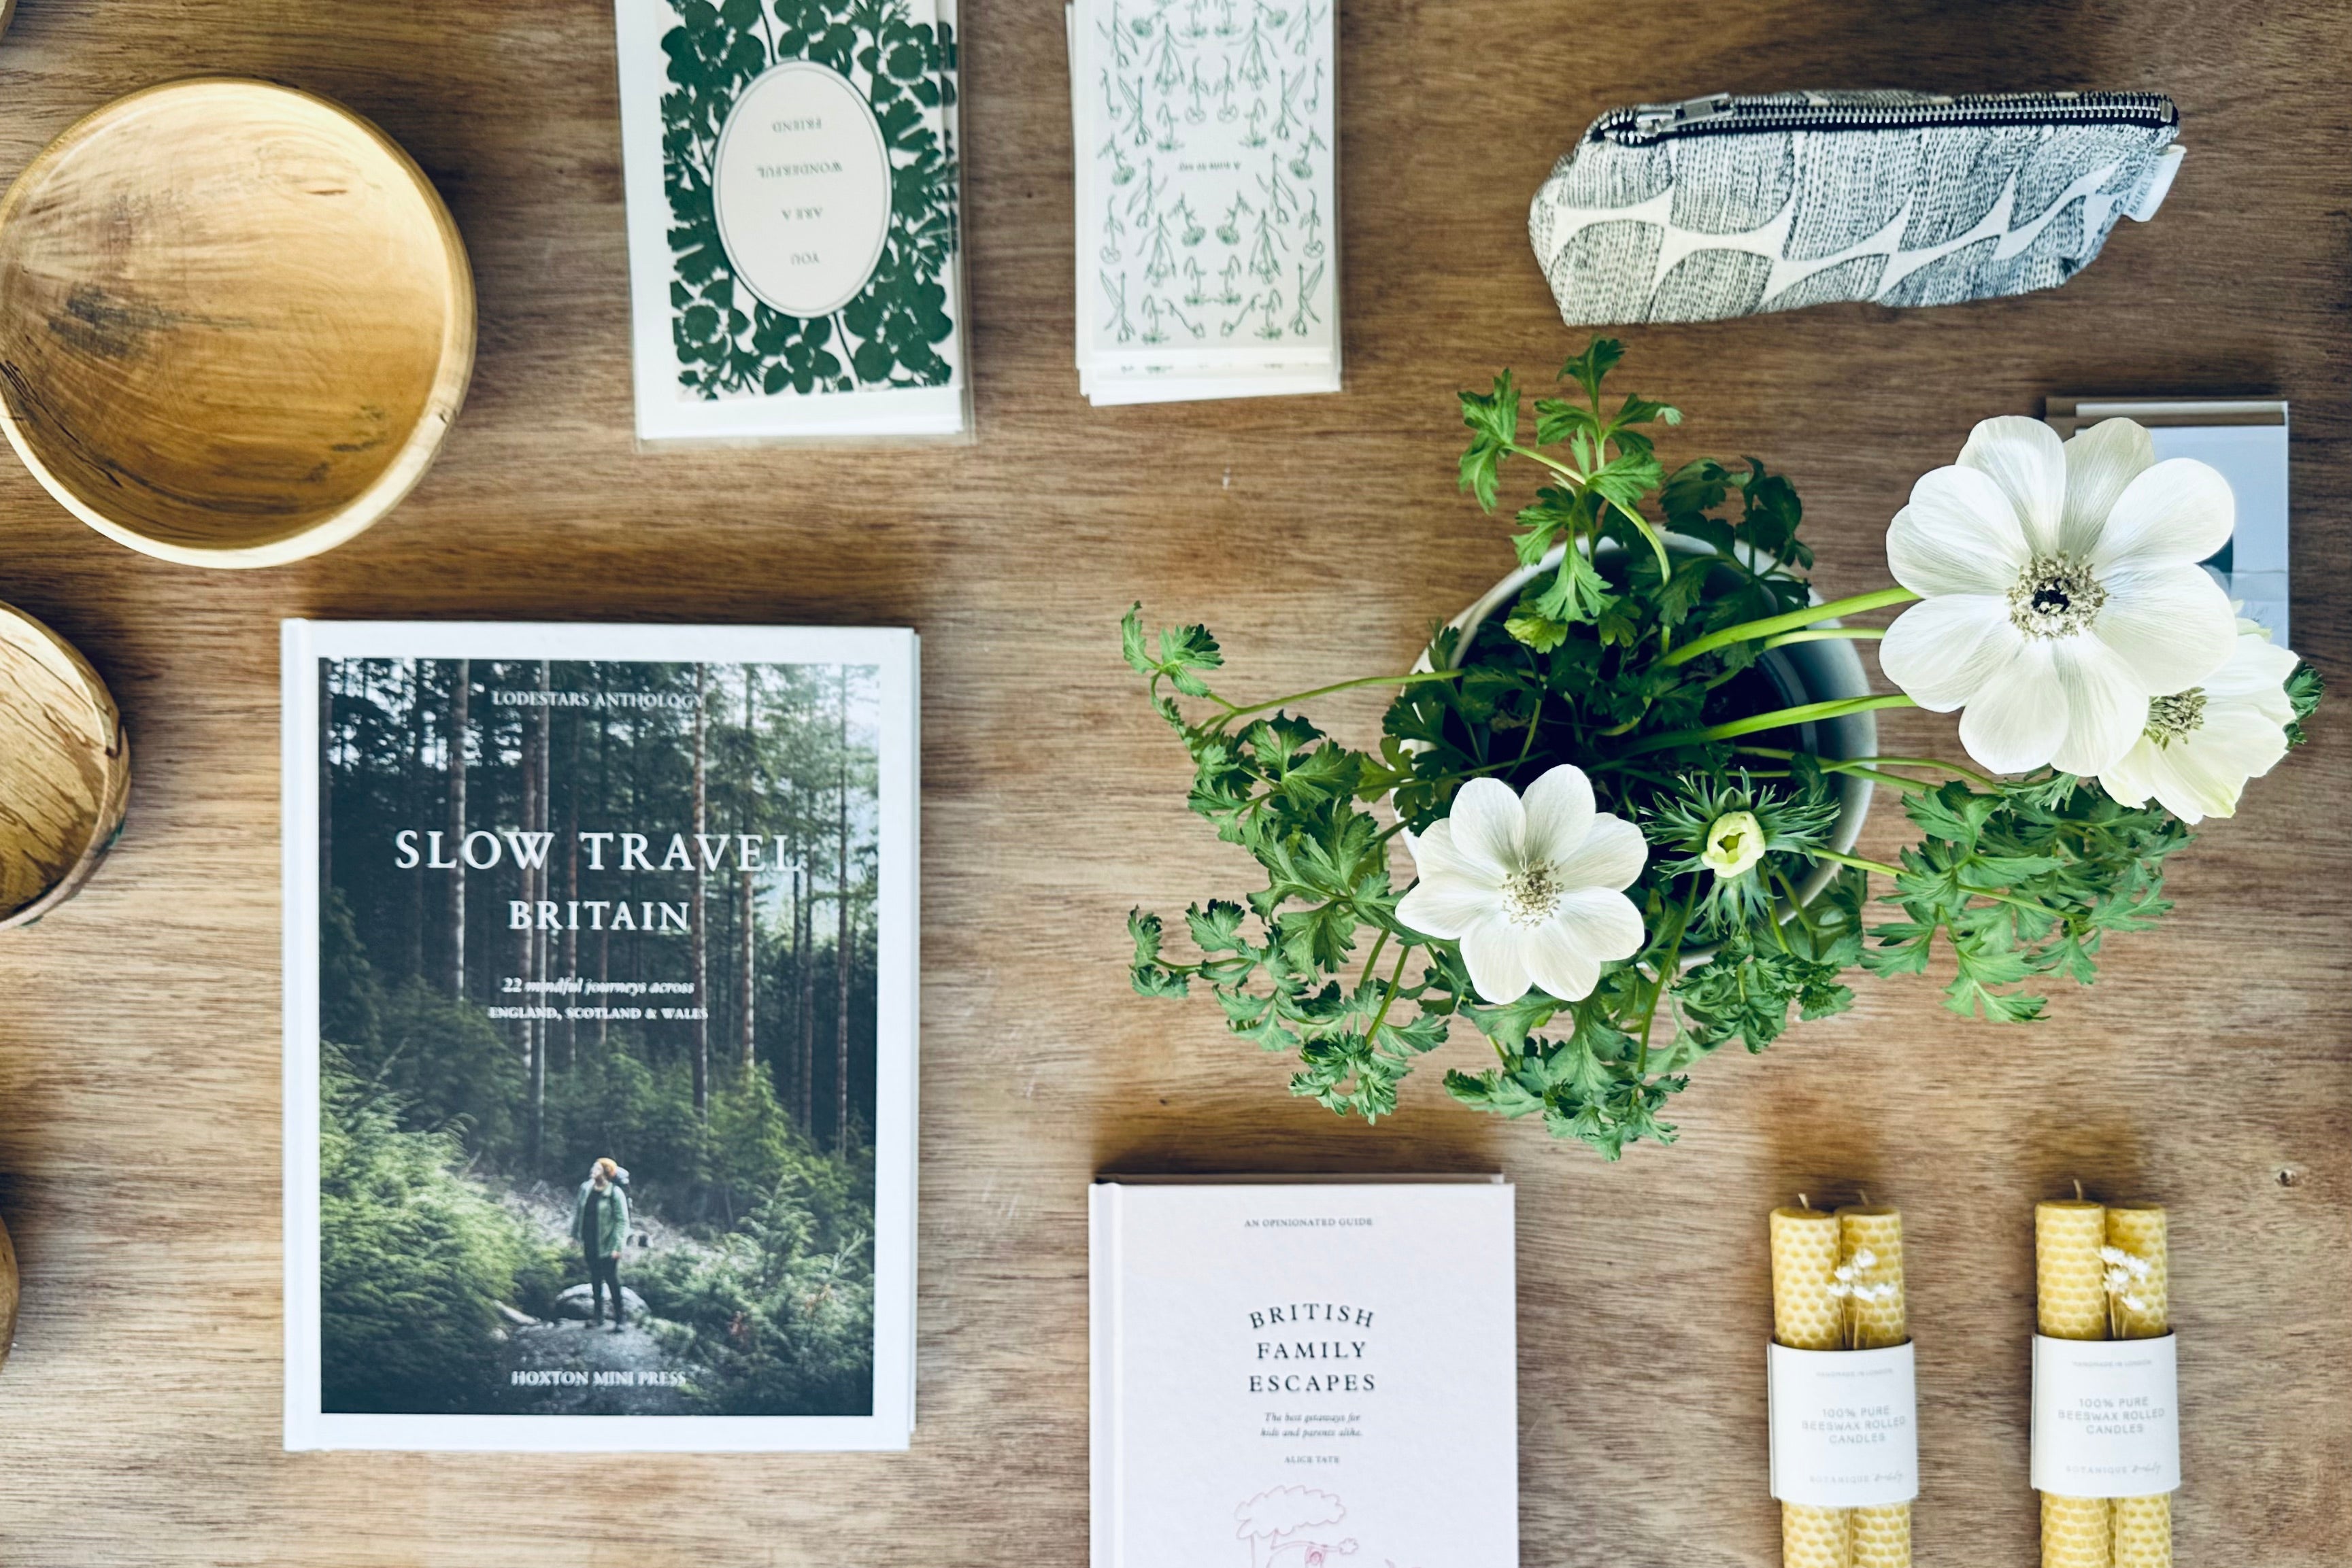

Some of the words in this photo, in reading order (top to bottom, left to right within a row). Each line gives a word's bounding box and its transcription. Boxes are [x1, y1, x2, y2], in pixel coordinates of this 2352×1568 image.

[772, 117, 822, 133] FRIEND
[756, 160, 843, 177] WONDERFUL
[781, 207, 792, 222] A
[796, 206, 823, 220] ARE
[790, 251, 820, 266] YOU
[492, 691, 590, 707] LODESTARS
[594, 692, 703, 709] ANTHOLOGY
[394, 830, 554, 870] SLOW
[578, 831, 805, 872] TRAVEL
[508, 900, 689, 931] BRITAIN
[501, 977, 522, 993] 22
[523, 977, 583, 995] mindful
[583, 978, 646, 997] journeys
[648, 983, 694, 994] across
[488, 1006, 562, 1021] ENGLAND,
[564, 1007, 641, 1019] SCOTLAND
[645, 1008, 656, 1019] &
[660, 1007, 709, 1019] WALES
[1245, 1219, 1259, 1227] AN
[1262, 1218, 1336, 1227] OPINIONATED
[1338, 1218, 1373, 1226] GUIDE
[1249, 1303, 1374, 1329] BRITISH
[1257, 1342, 1366, 1359] FAMILY
[511, 1370, 589, 1386] HOXTON
[592, 1371, 634, 1386] MINI
[637, 1371, 686, 1387] PRESS
[1249, 1374, 1375, 1393] ESCAPES
[2079, 1398, 2114, 1408] 100%
[2119, 1397, 2149, 1407] PURE
[1264, 1412, 1281, 1421] The
[1284, 1412, 1302, 1421] best
[1304, 1413, 1345, 1423] getaways
[1347, 1412, 1360, 1423] for
[1823, 1408, 1856, 1418] 100%
[1861, 1405, 1890, 1416] PURE
[2058, 1410, 2119, 1421] BEESWAX
[2123, 1408, 2165, 1420] ROLLED
[1802, 1420, 1860, 1431] BEESWAX
[1865, 1416, 1906, 1429] ROLLED
[2085, 1424, 2144, 1434] CANDLES
[1260, 1428, 1279, 1437] kids
[1282, 1428, 1300, 1436] and
[1302, 1429, 1335, 1439] parents
[1829, 1433, 1886, 1444] CANDLES
